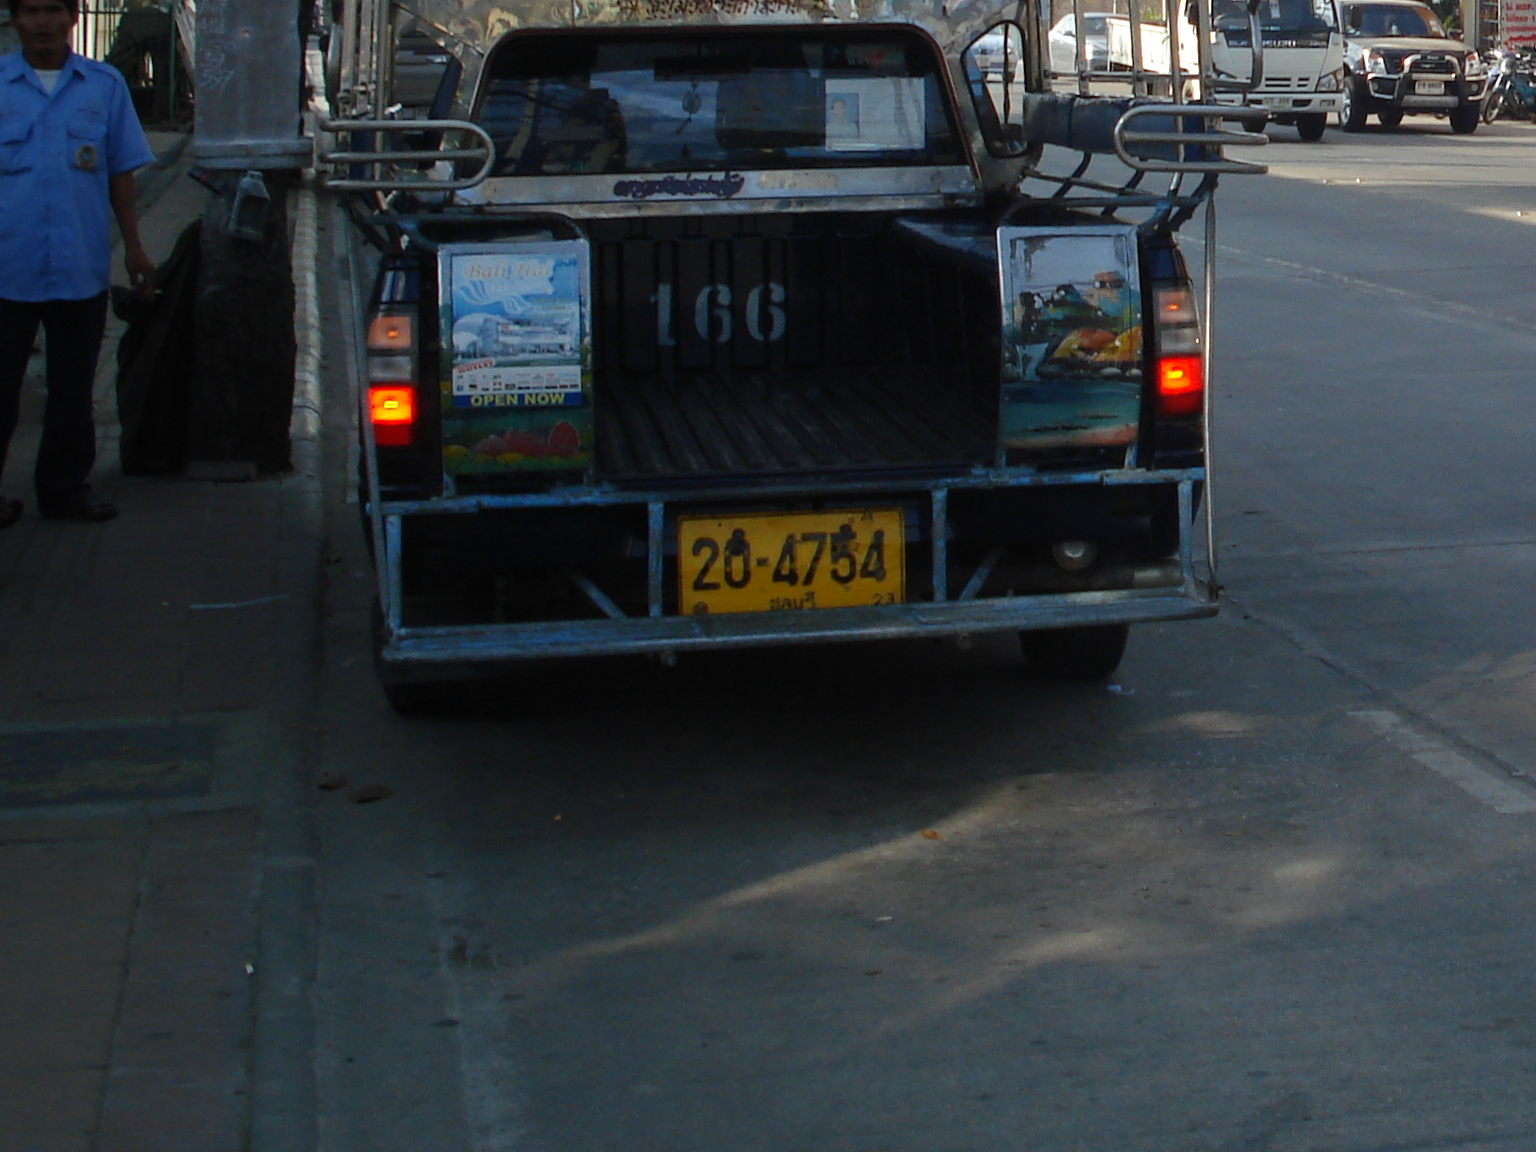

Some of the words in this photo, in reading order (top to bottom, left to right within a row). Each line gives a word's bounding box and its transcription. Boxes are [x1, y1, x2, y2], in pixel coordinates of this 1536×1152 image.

[649, 281, 787, 346] 166
[470, 394, 518, 407] OPEN
[524, 392, 566, 405] NOW
[692, 525, 886, 591] 20-4754
